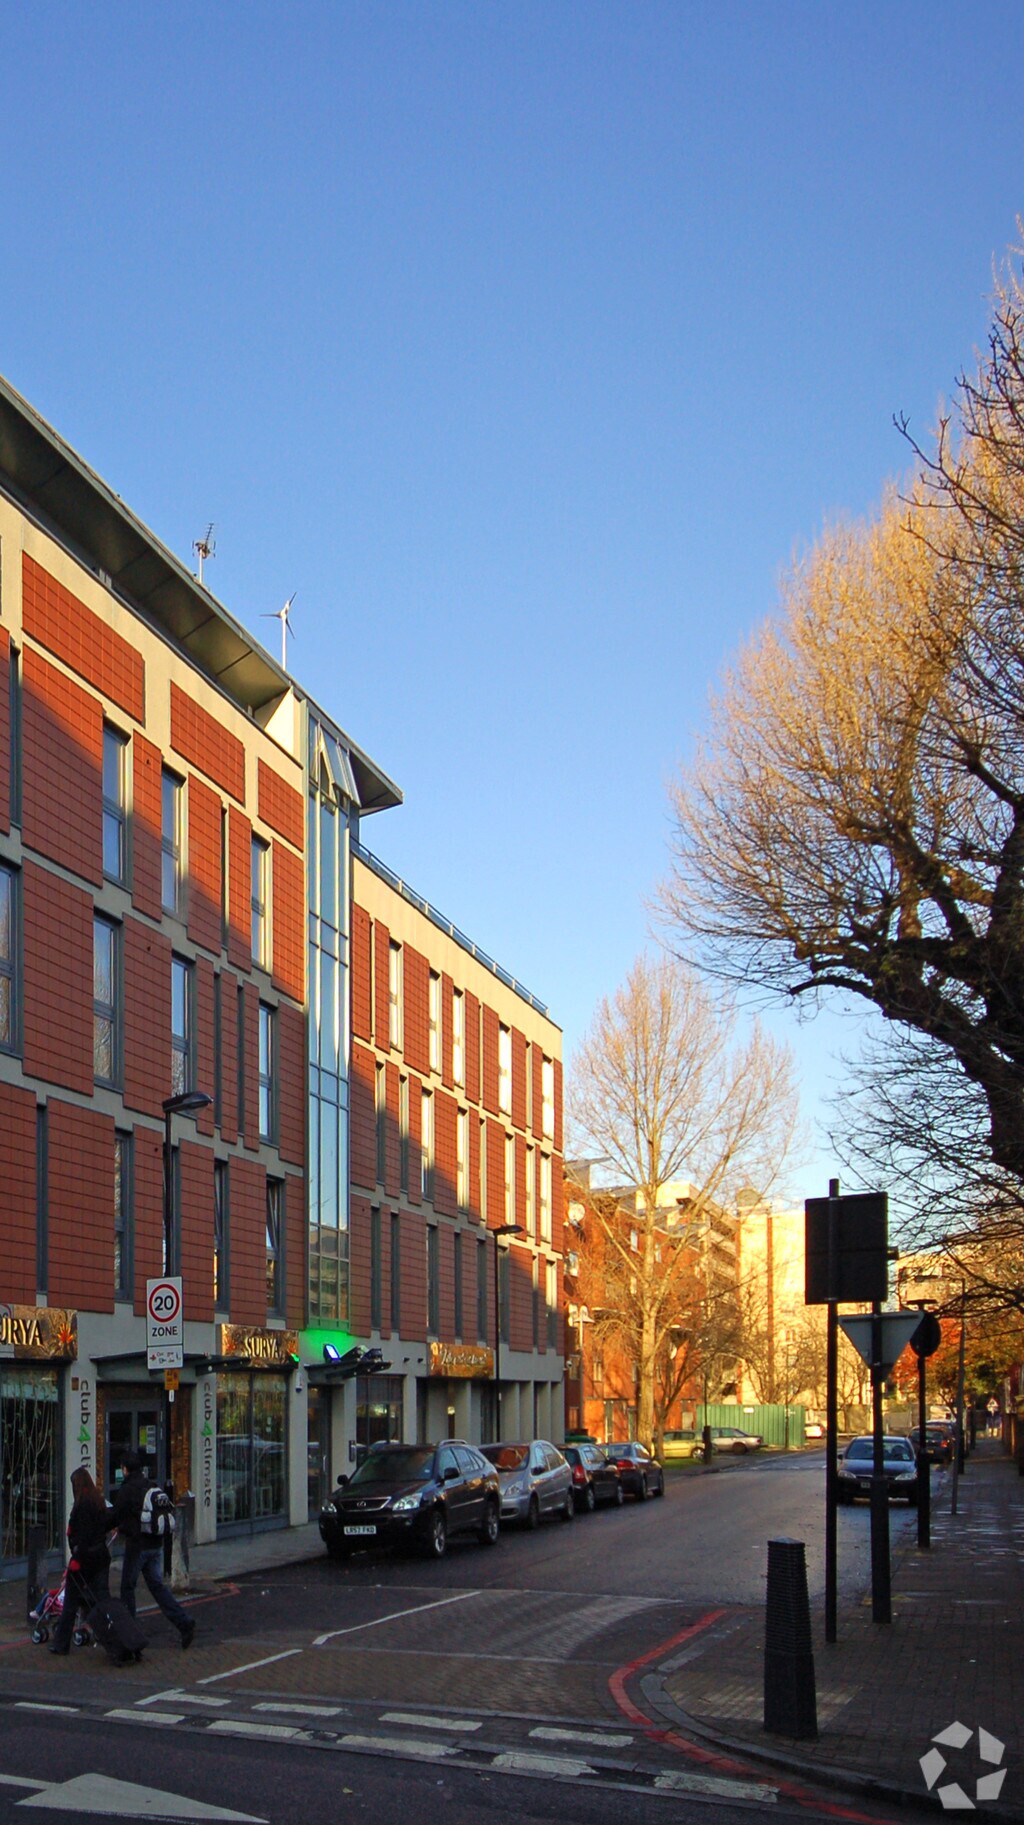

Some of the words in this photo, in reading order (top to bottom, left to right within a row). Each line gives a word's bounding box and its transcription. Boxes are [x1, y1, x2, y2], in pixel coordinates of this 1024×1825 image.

[154, 1295, 174, 1311] 20
[151, 1326, 179, 1337] ZONE
[244, 1336, 281, 1358] SURYA
